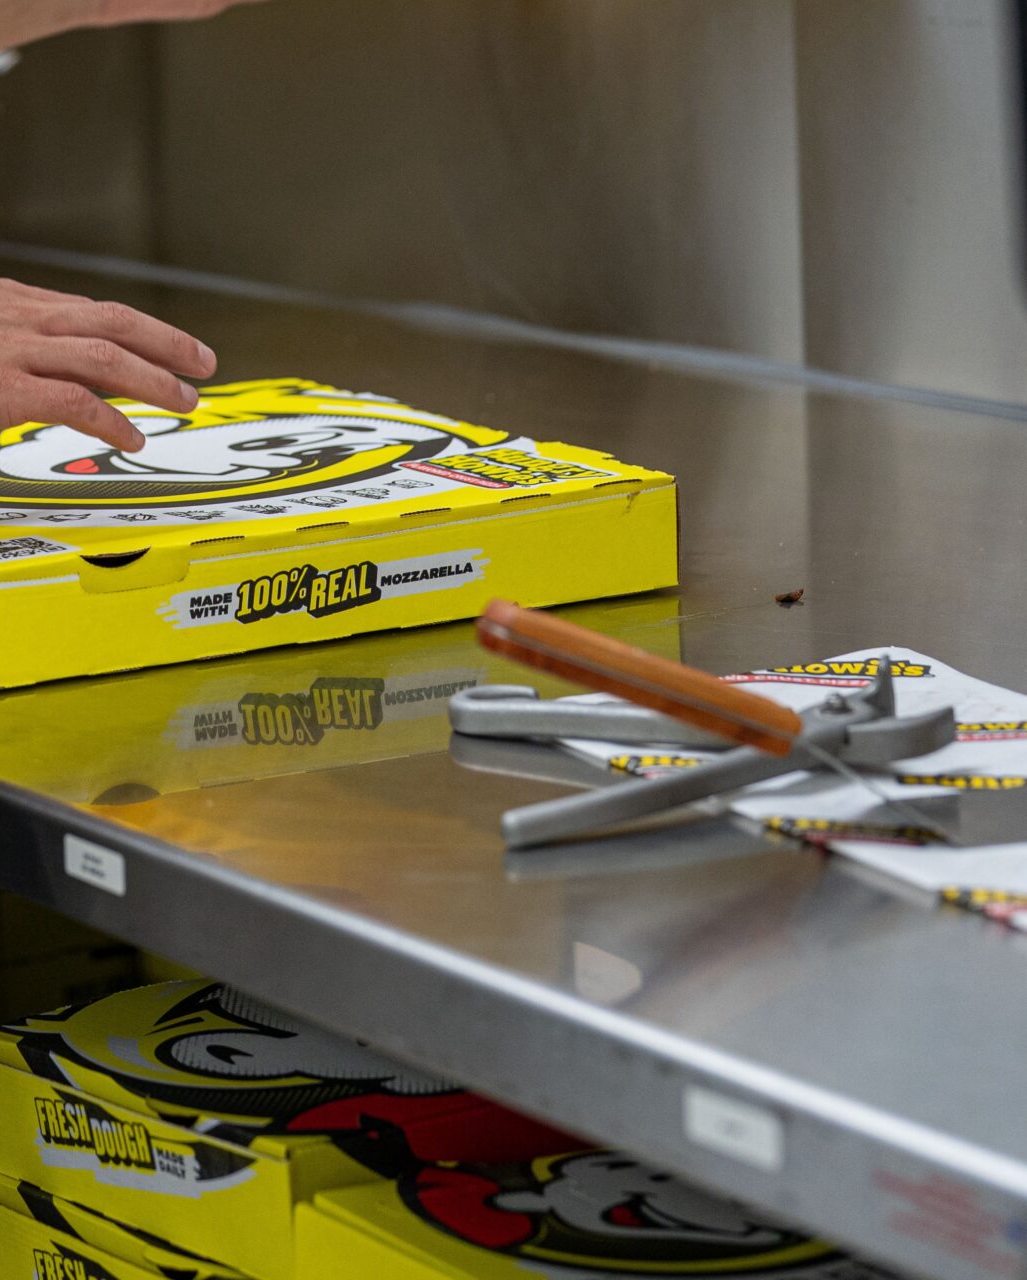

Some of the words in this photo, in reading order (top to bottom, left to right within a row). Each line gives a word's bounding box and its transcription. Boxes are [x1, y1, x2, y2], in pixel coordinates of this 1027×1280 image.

[189, 592, 233, 608] MADE
[236, 565, 311, 622] 100%
[308, 561, 378, 616] REAL
[380, 562, 474, 587] MOZZARELLA
[189, 605, 229, 620] WITH
[34, 1097, 93, 1147] FRESH
[89, 1118, 156, 1169] DOUGH
[156, 1146, 185, 1166] MADE
[158, 1160, 186, 1180] DAILY
[33, 1248, 90, 1280] FRESH
